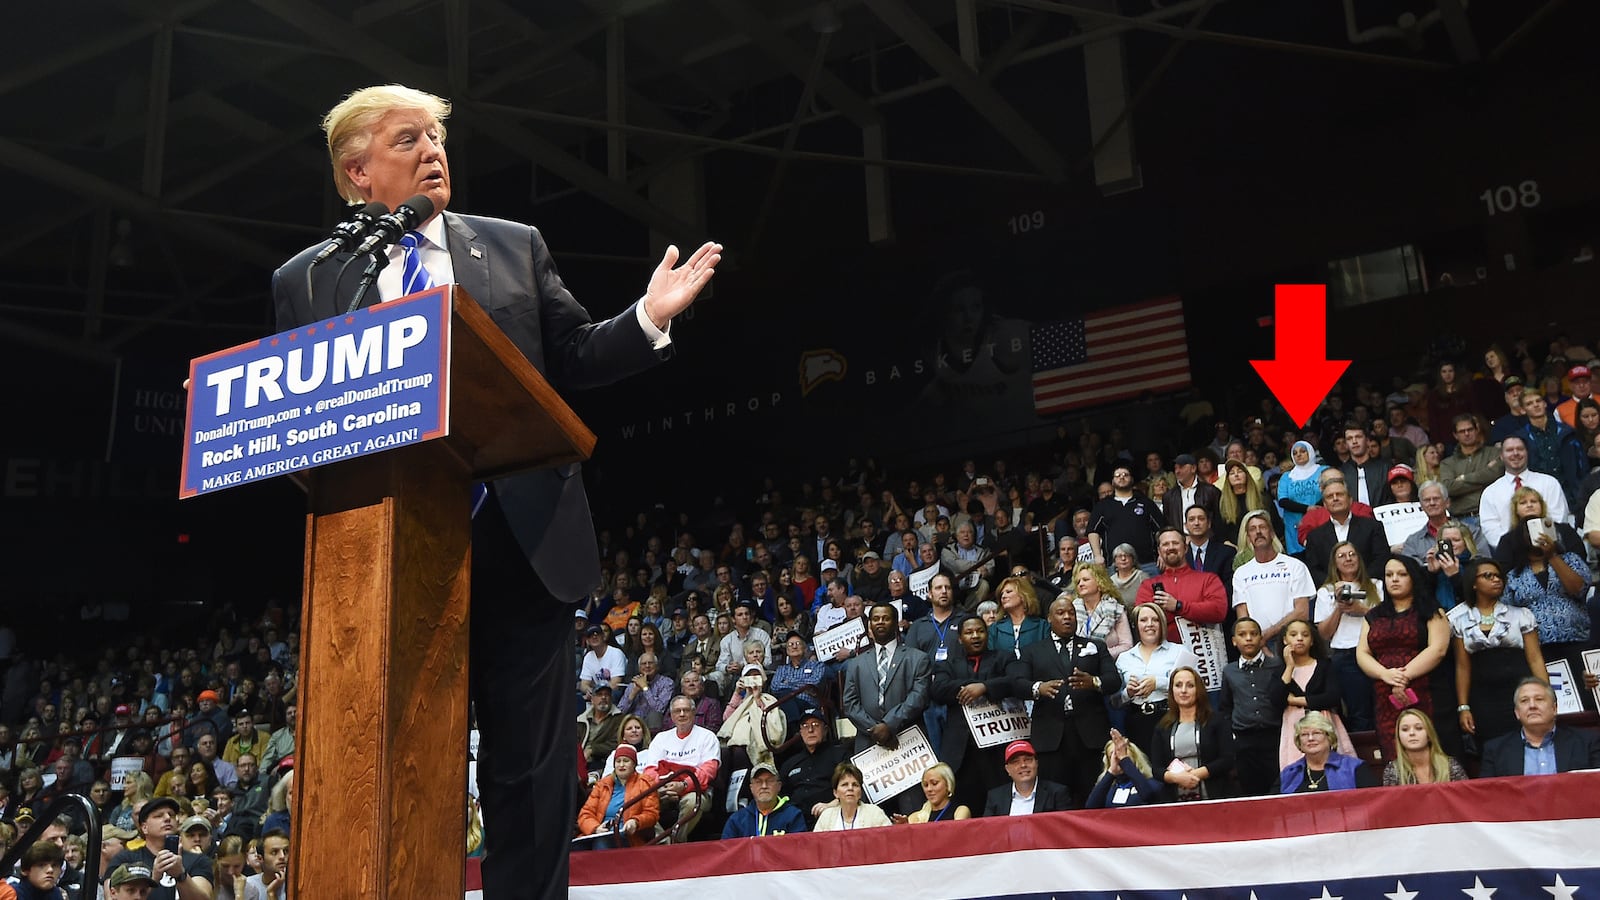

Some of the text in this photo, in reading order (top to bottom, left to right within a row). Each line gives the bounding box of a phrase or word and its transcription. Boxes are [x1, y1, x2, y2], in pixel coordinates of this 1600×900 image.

[1480, 181, 1541, 216] 108
[1008, 210, 1045, 235] 109
[207, 315, 428, 416] TRUMP
[194, 373, 433, 444] DonaldJTrump.com @realDonaldTrump
[621, 392, 781, 440] WINTHROP
[201, 401, 421, 468] Rock Hill, South Carolina
[202, 428, 418, 490] MAKE AMERICA GREAT AGAIN!
[1243, 572, 1291, 583] TRUMP
[1187, 624, 1210, 687] TRUMP
[1209, 659, 1219, 686] WITH
[972, 709, 1007, 721] STANDS
[975, 716, 1030, 737] TRUMP
[665, 748, 696, 757] TRUMP
[864, 756, 901, 780] STANDS
[901, 742, 926, 760] WITH
[868, 753, 931, 793] TRUMP
